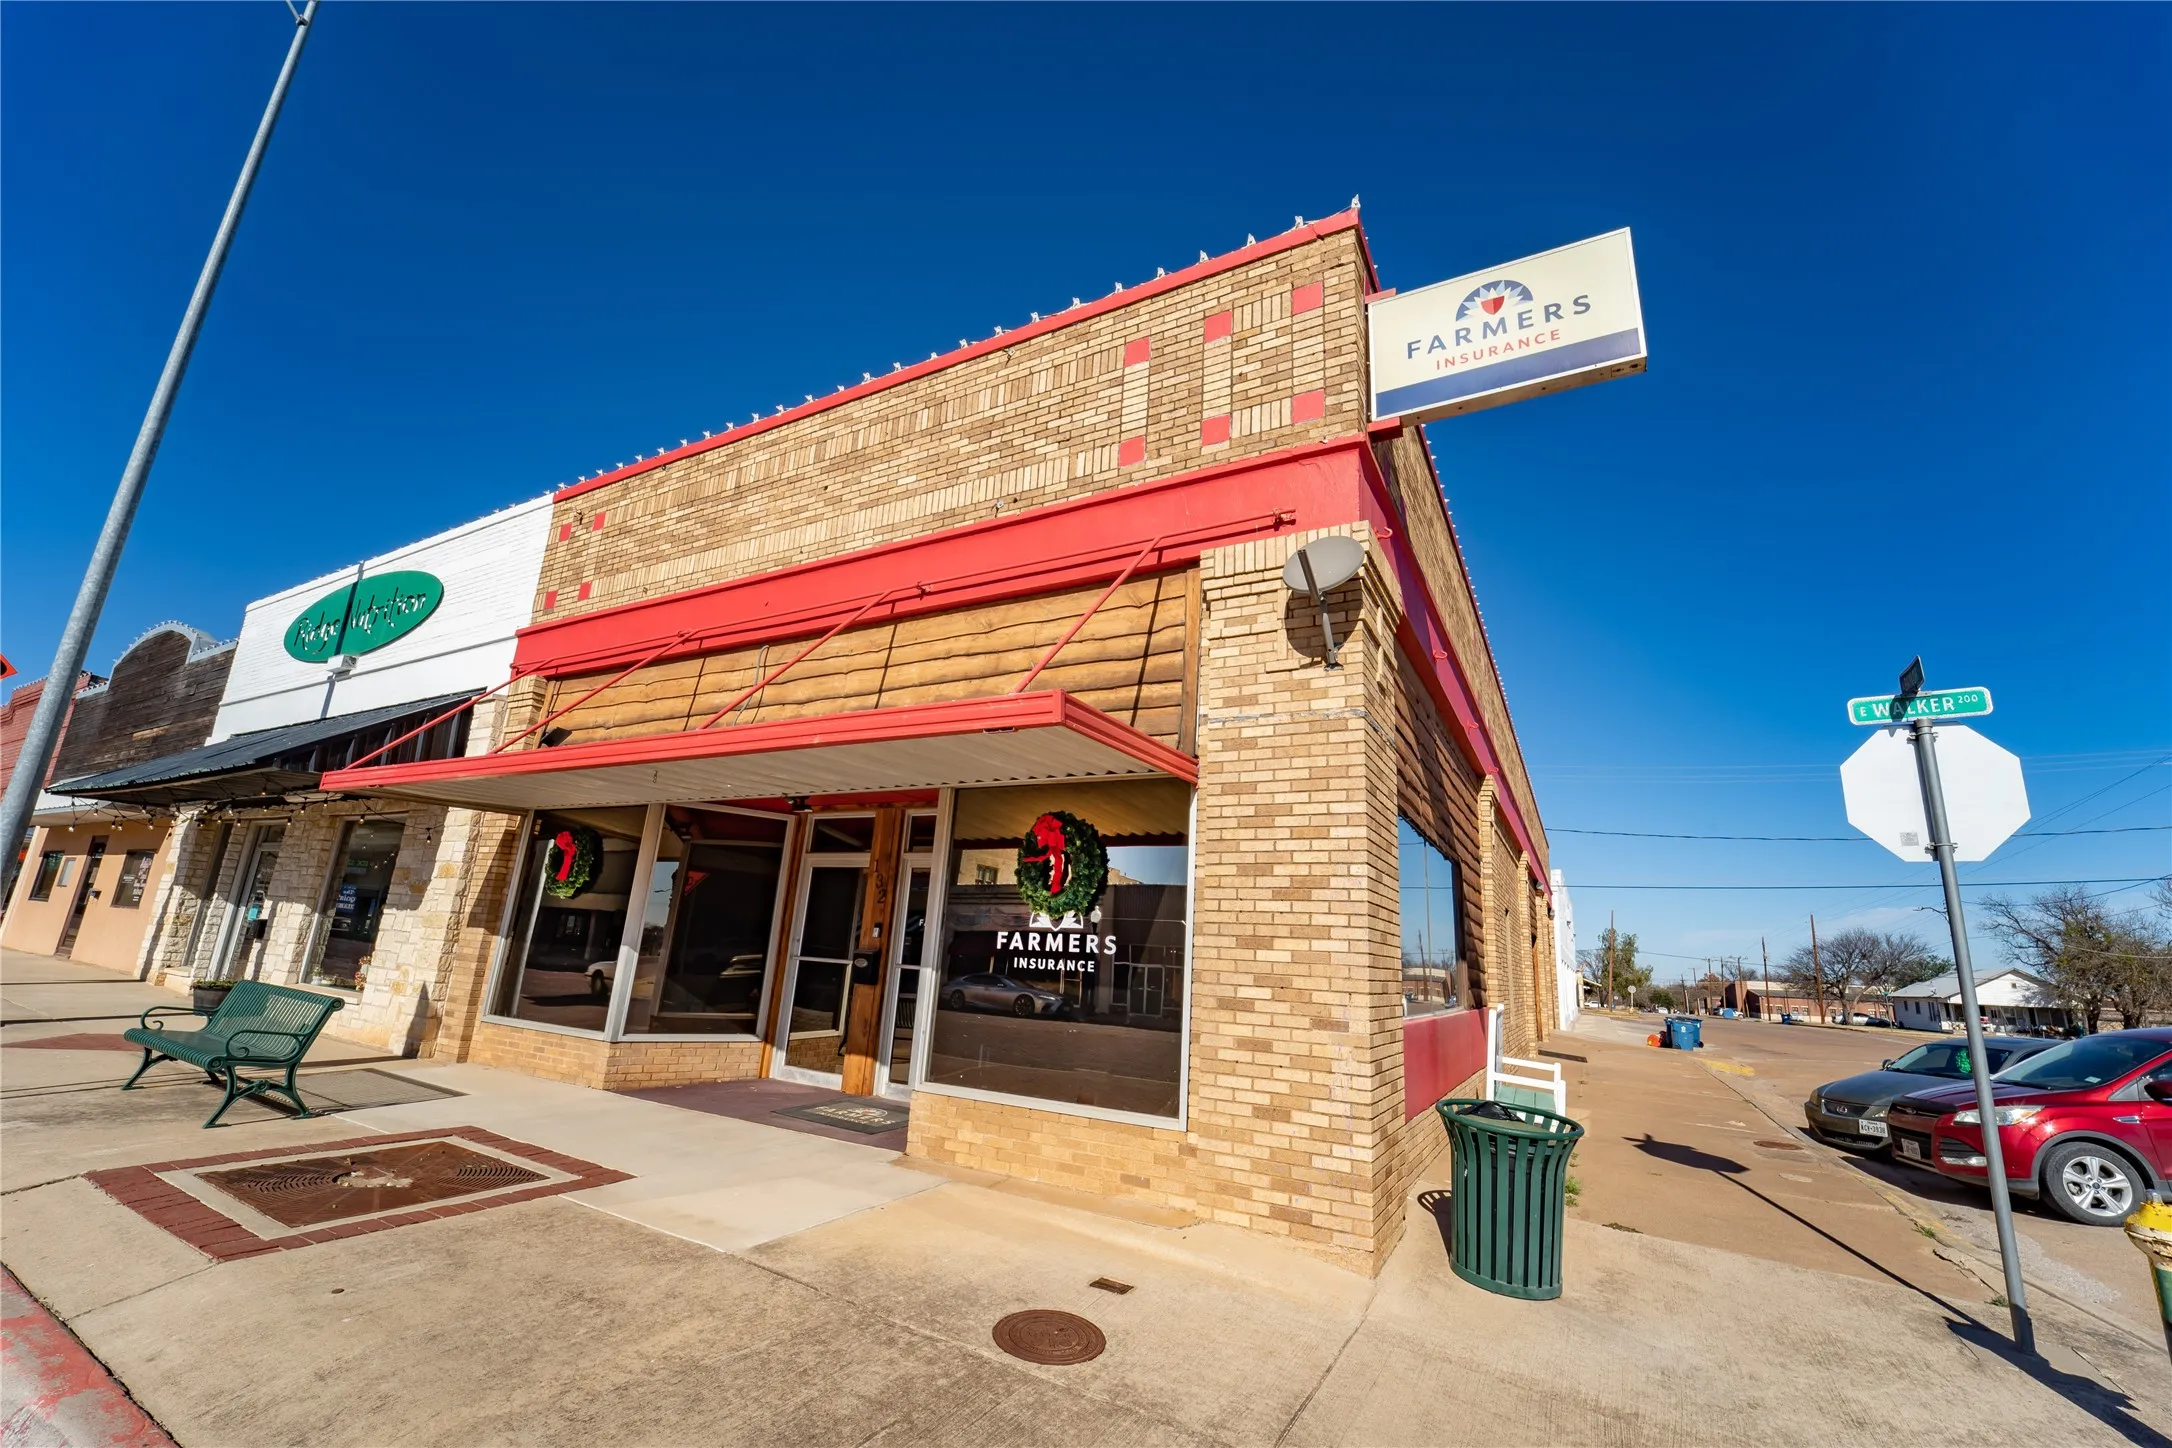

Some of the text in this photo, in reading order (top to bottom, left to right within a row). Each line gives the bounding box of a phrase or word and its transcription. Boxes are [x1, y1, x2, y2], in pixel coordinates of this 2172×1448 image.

[1406, 294, 1591, 360] FARMERS
[1435, 328, 1561, 371] INSURANCE
[293, 586, 427, 655] Ridge Nutrition
[1859, 694, 1979, 718] E WALKER 200
[996, 931, 1117, 955] FARMERS
[1013, 957, 1095, 973] INSURANCE
